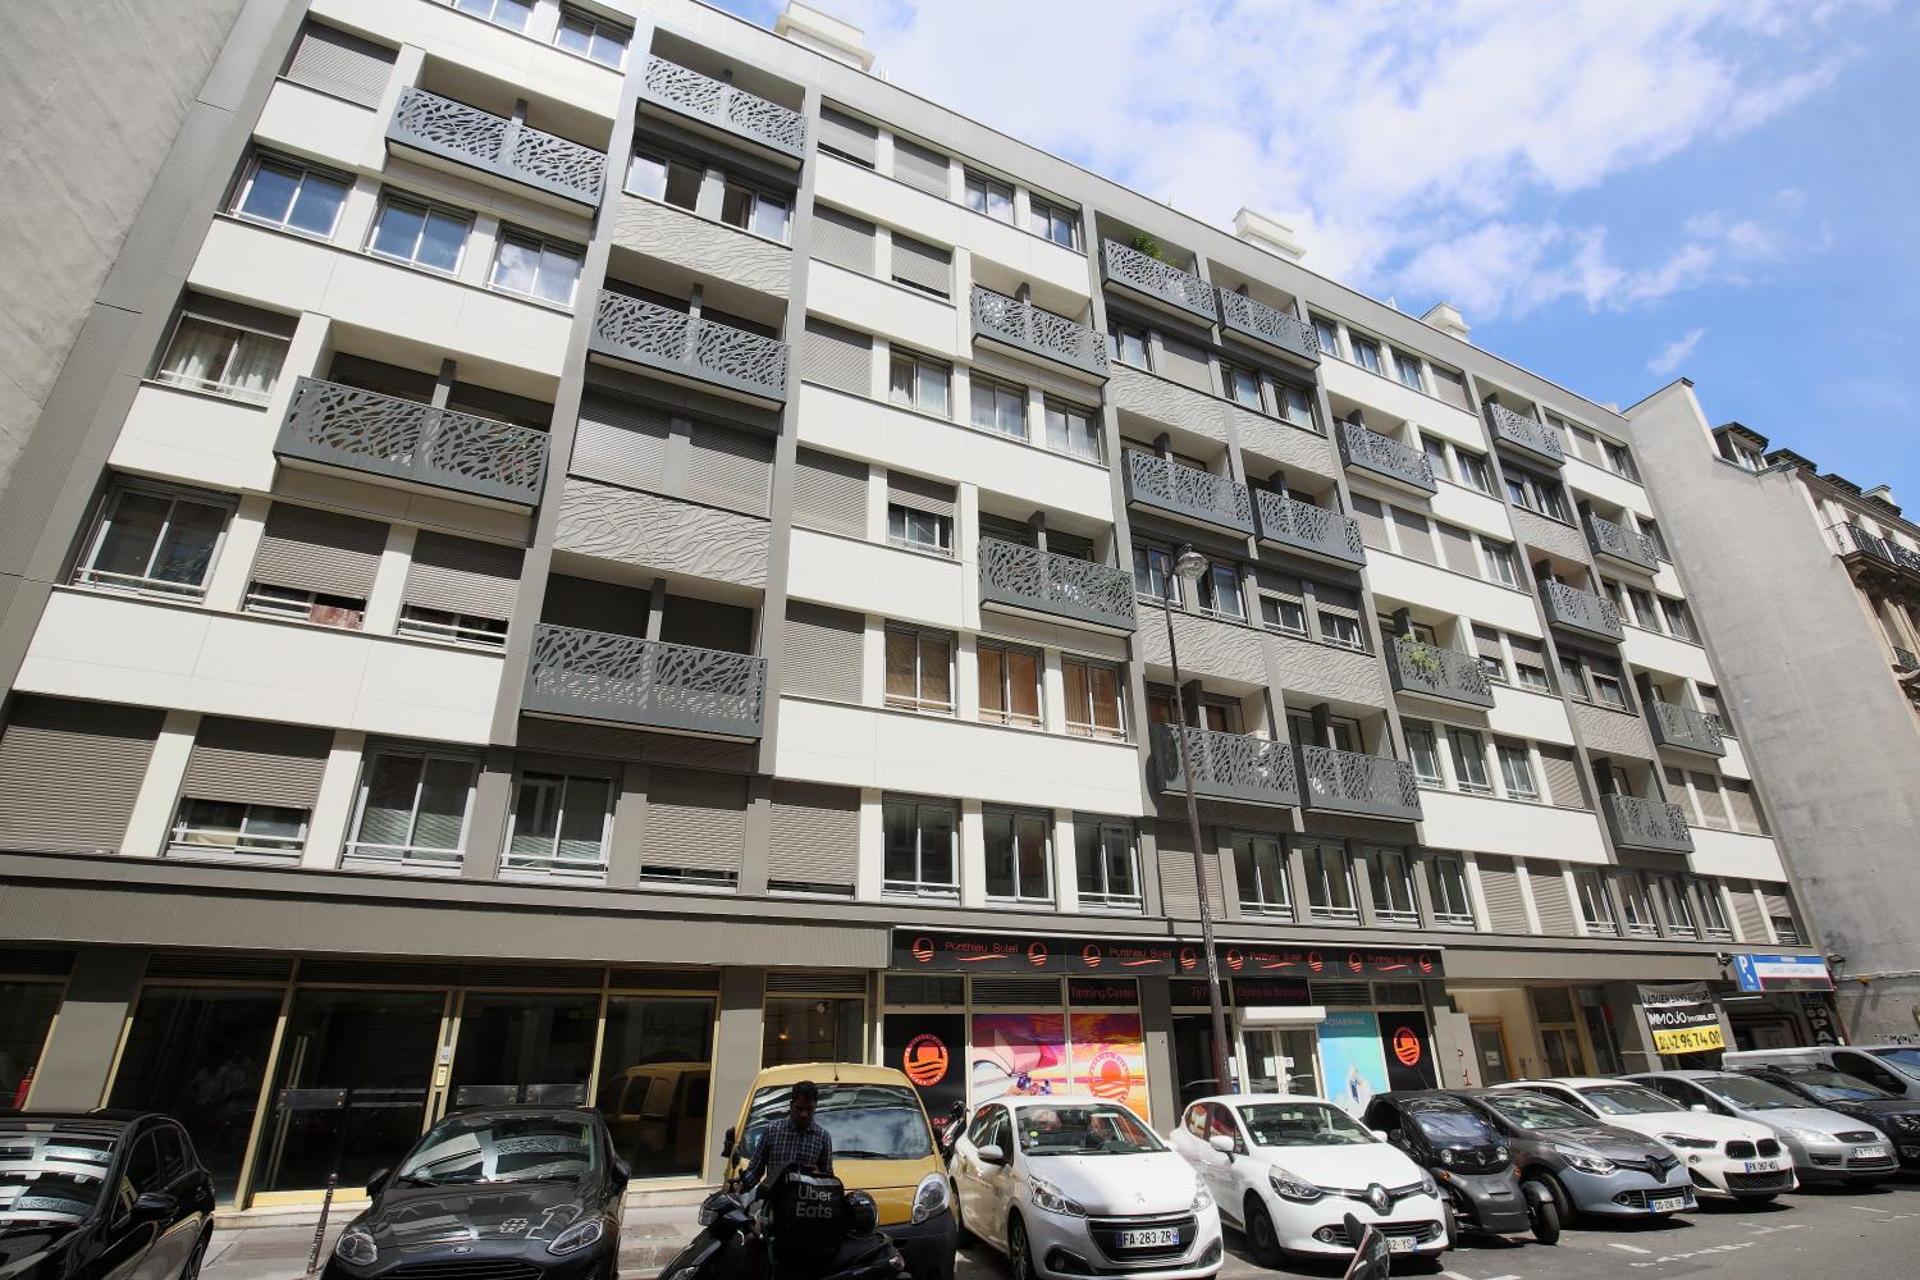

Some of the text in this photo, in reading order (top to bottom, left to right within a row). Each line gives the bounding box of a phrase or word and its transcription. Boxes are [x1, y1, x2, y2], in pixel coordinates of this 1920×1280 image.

[992, 941, 1019, 953] Soleil
[1738, 955, 1748, 972] P
[798, 1185, 833, 1202] Uber
[795, 1202, 833, 1219] Eats
